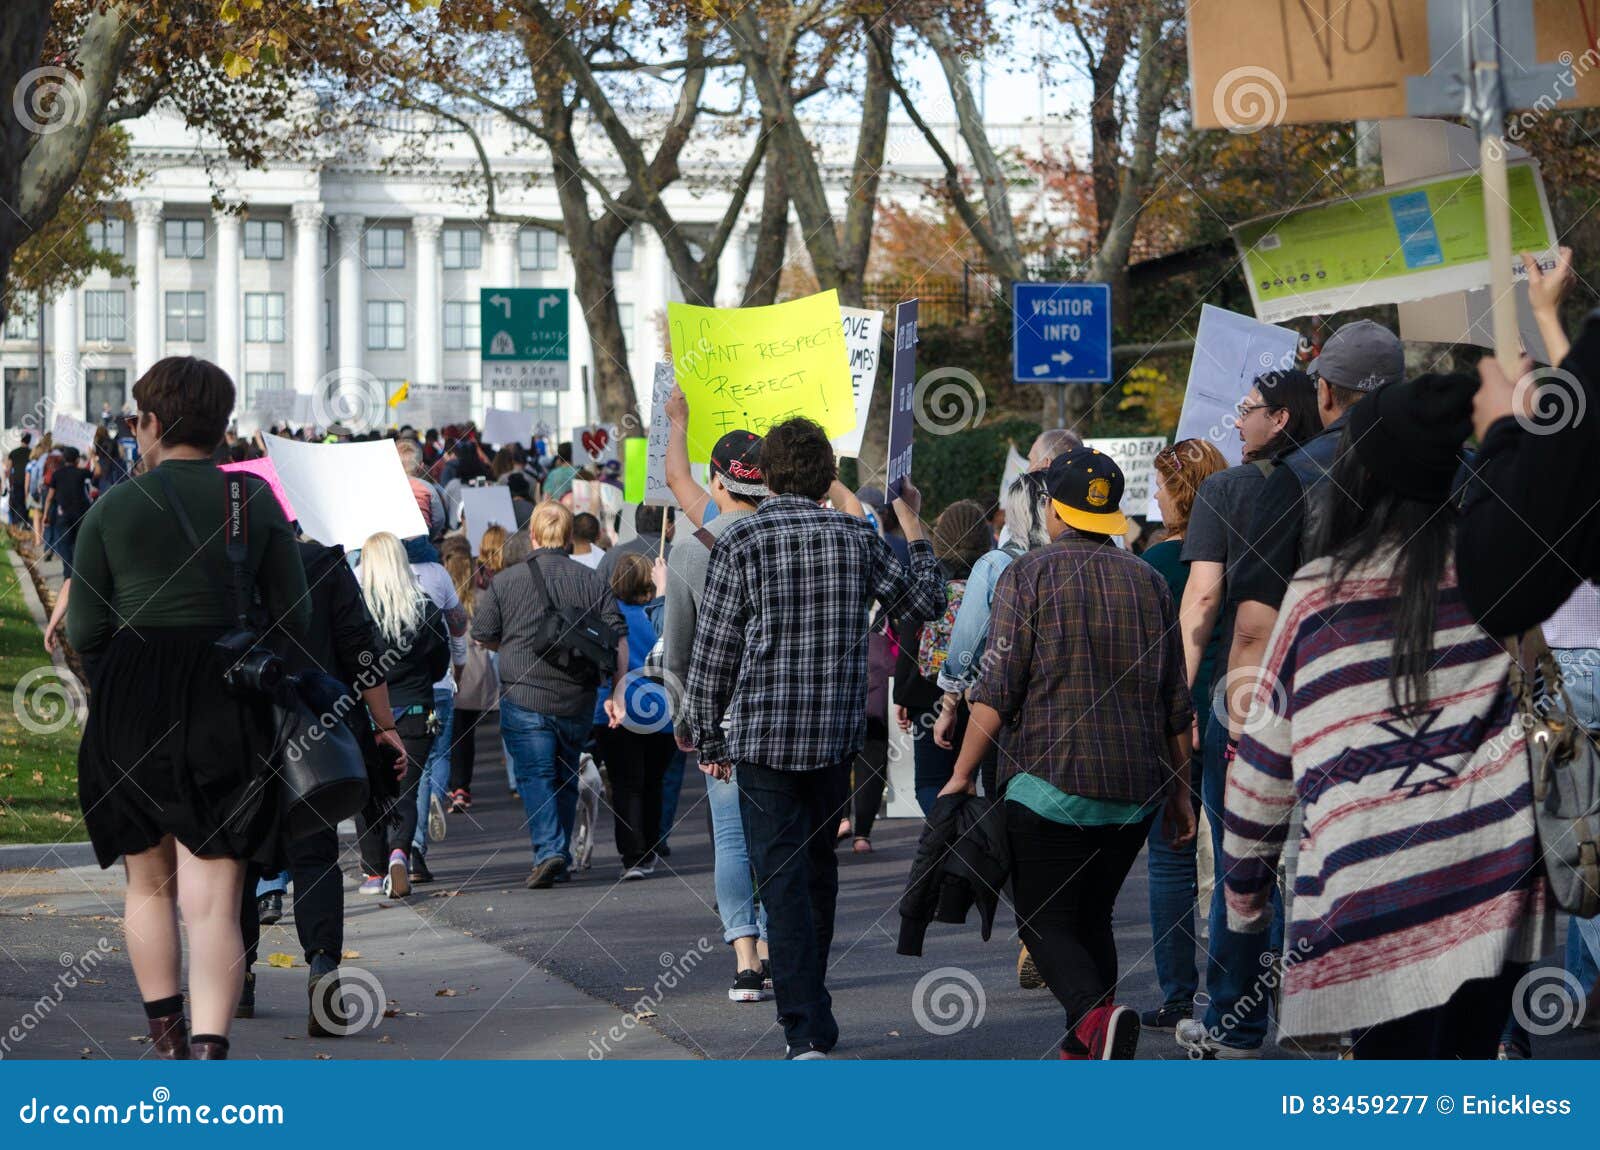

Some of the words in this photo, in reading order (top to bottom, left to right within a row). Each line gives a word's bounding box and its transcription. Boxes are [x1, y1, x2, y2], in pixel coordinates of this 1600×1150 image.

[1031, 299, 1093, 316] VISITOR
[531, 331, 565, 341] STATE
[842, 316, 871, 340] OVE
[1044, 324, 1081, 341] INFO
[495, 366, 514, 375] NO
[521, 366, 556, 376] STOP
[492, 378, 560, 388] REQUIRED
[705, 371, 805, 408] RESPECT
[231, 481, 240, 499] EOS
[232, 501, 240, 537] DIGITAL
